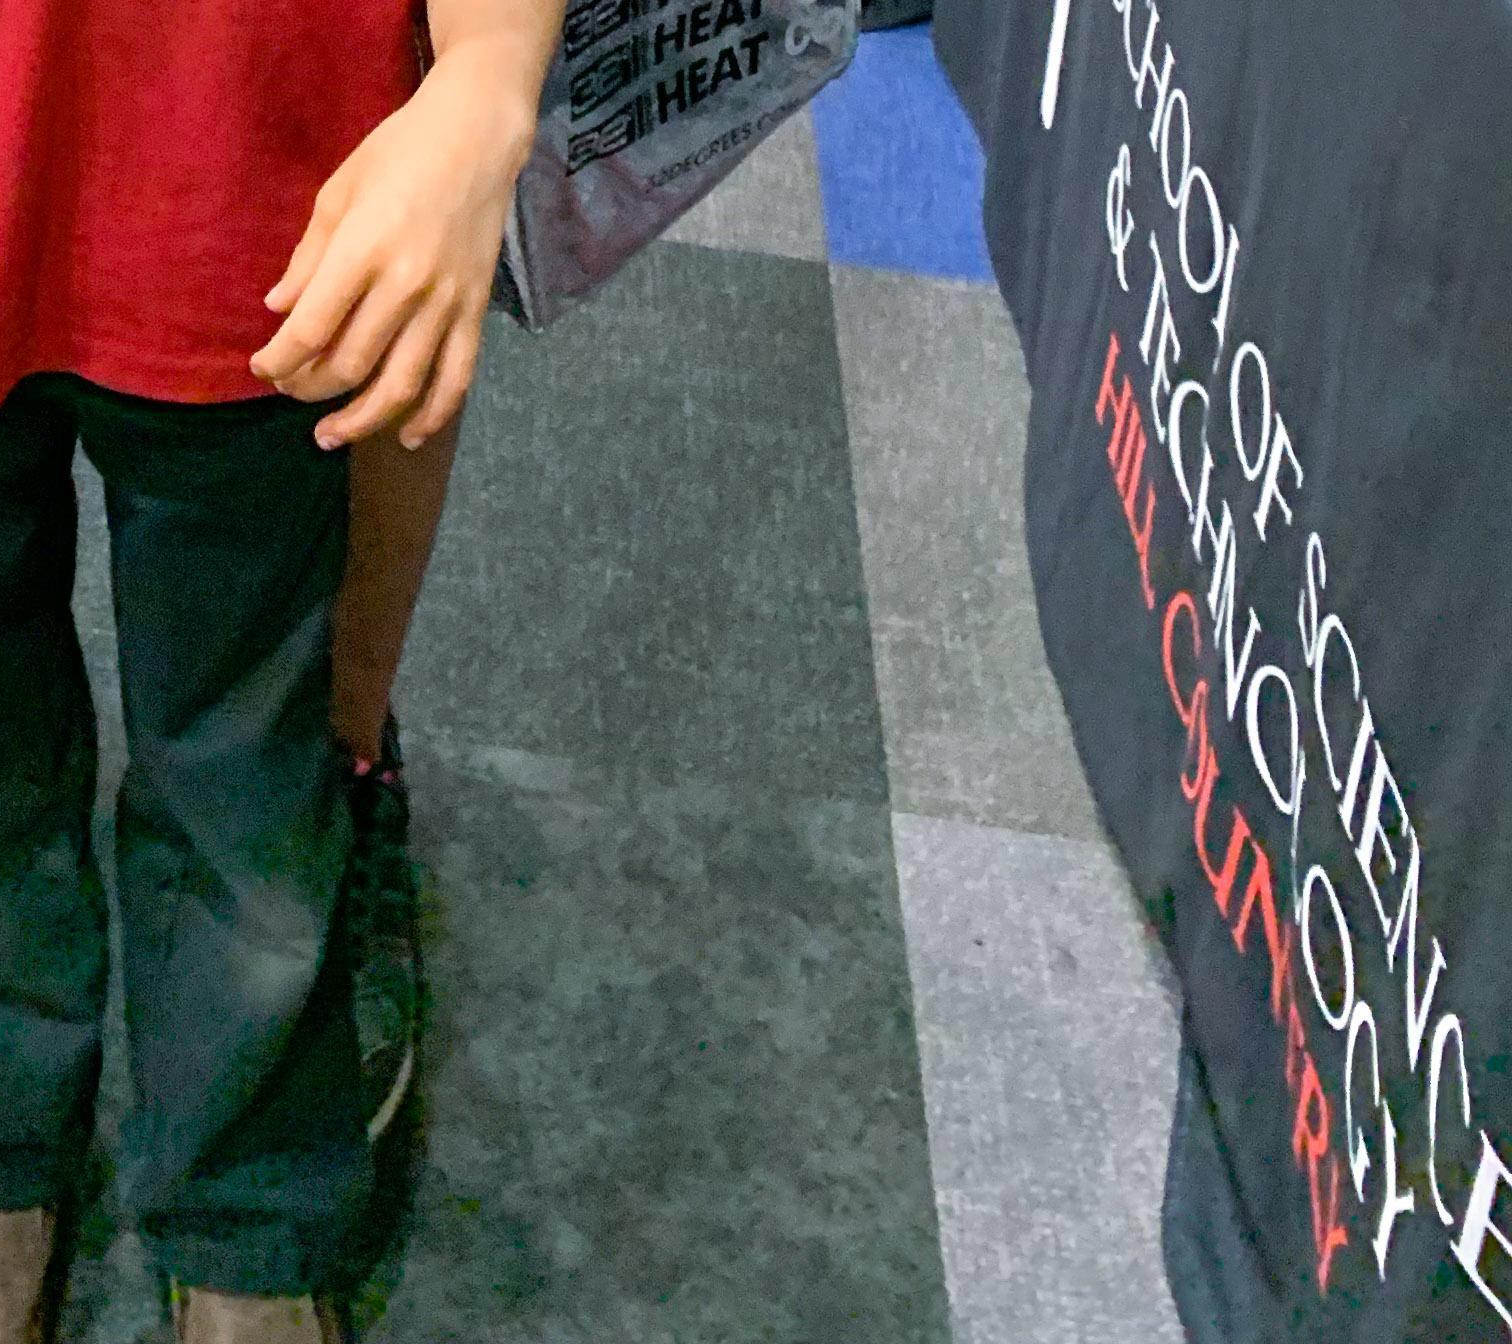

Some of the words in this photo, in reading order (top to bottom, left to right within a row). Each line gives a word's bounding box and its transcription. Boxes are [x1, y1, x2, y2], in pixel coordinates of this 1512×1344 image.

[656, 31, 770, 125] HEAT
[1106, 143, 1135, 291] &
[1095, 331, 1160, 611] HILL
[1229, 341, 1303, 543] OF
